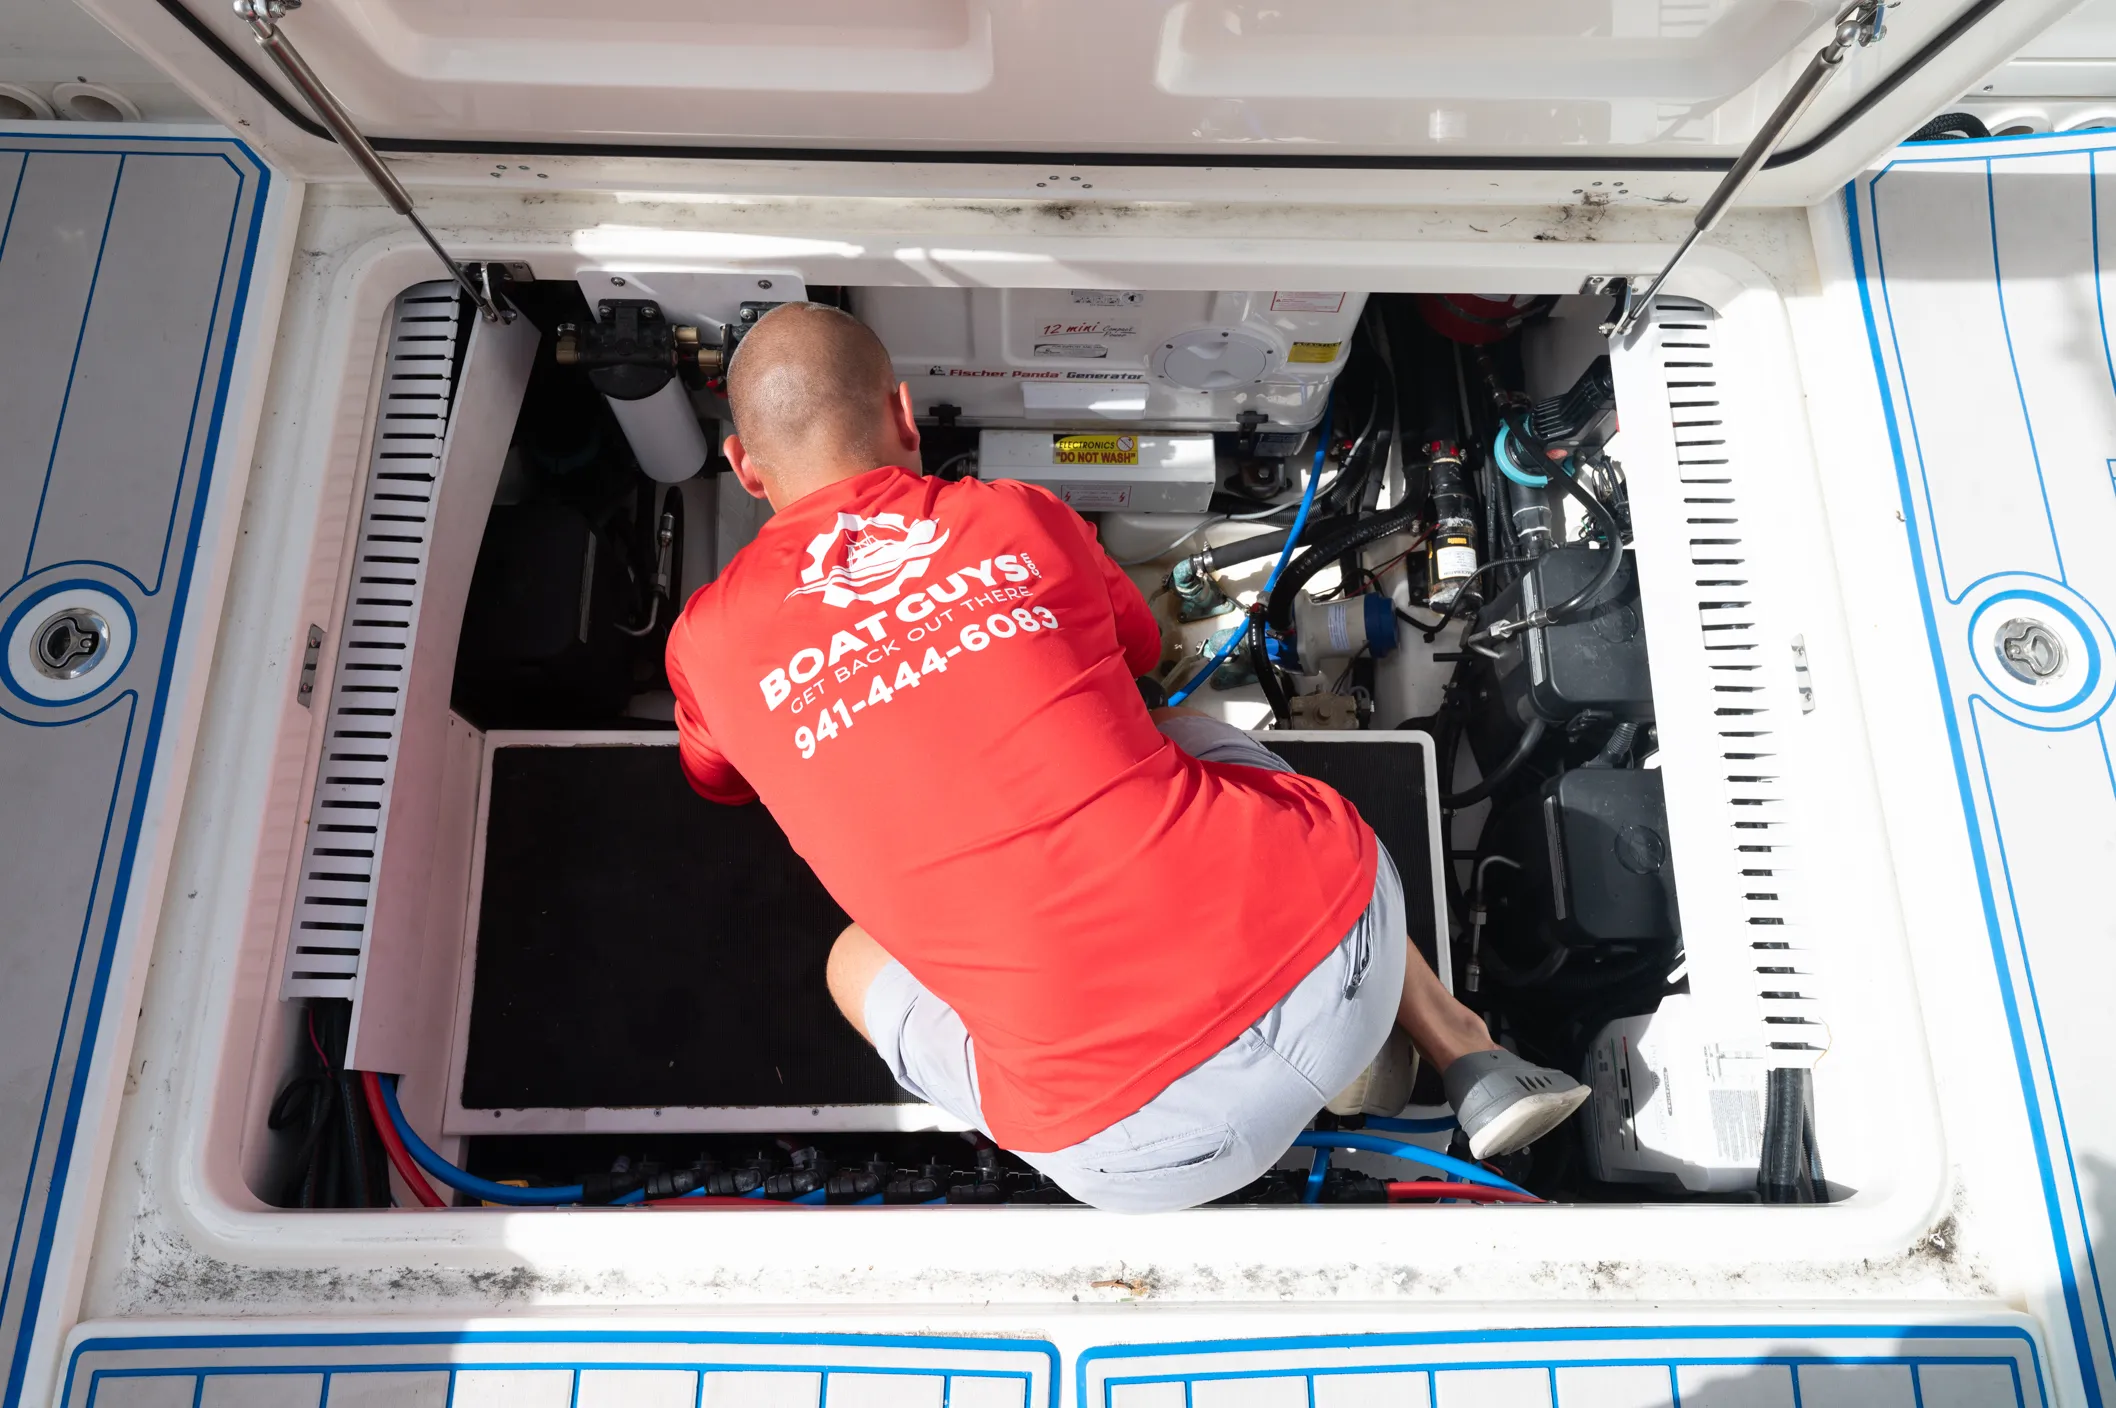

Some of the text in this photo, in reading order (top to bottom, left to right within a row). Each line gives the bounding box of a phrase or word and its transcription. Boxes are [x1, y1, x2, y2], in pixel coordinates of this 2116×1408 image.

[1043, 321, 1101, 335] 12 mini
[950, 369, 1007, 378] Fischer
[1066, 371, 1144, 380] Generator
[1059, 441, 1115, 450] ELECTRONICS
[1078, 451, 1099, 463] NOT
[759, 609, 889, 712] BOAT
[895, 553, 1031, 623] GUYS
[790, 585, 1034, 714] GET BACK OUT THERE
[794, 605, 1060, 760] 941-444-6083
